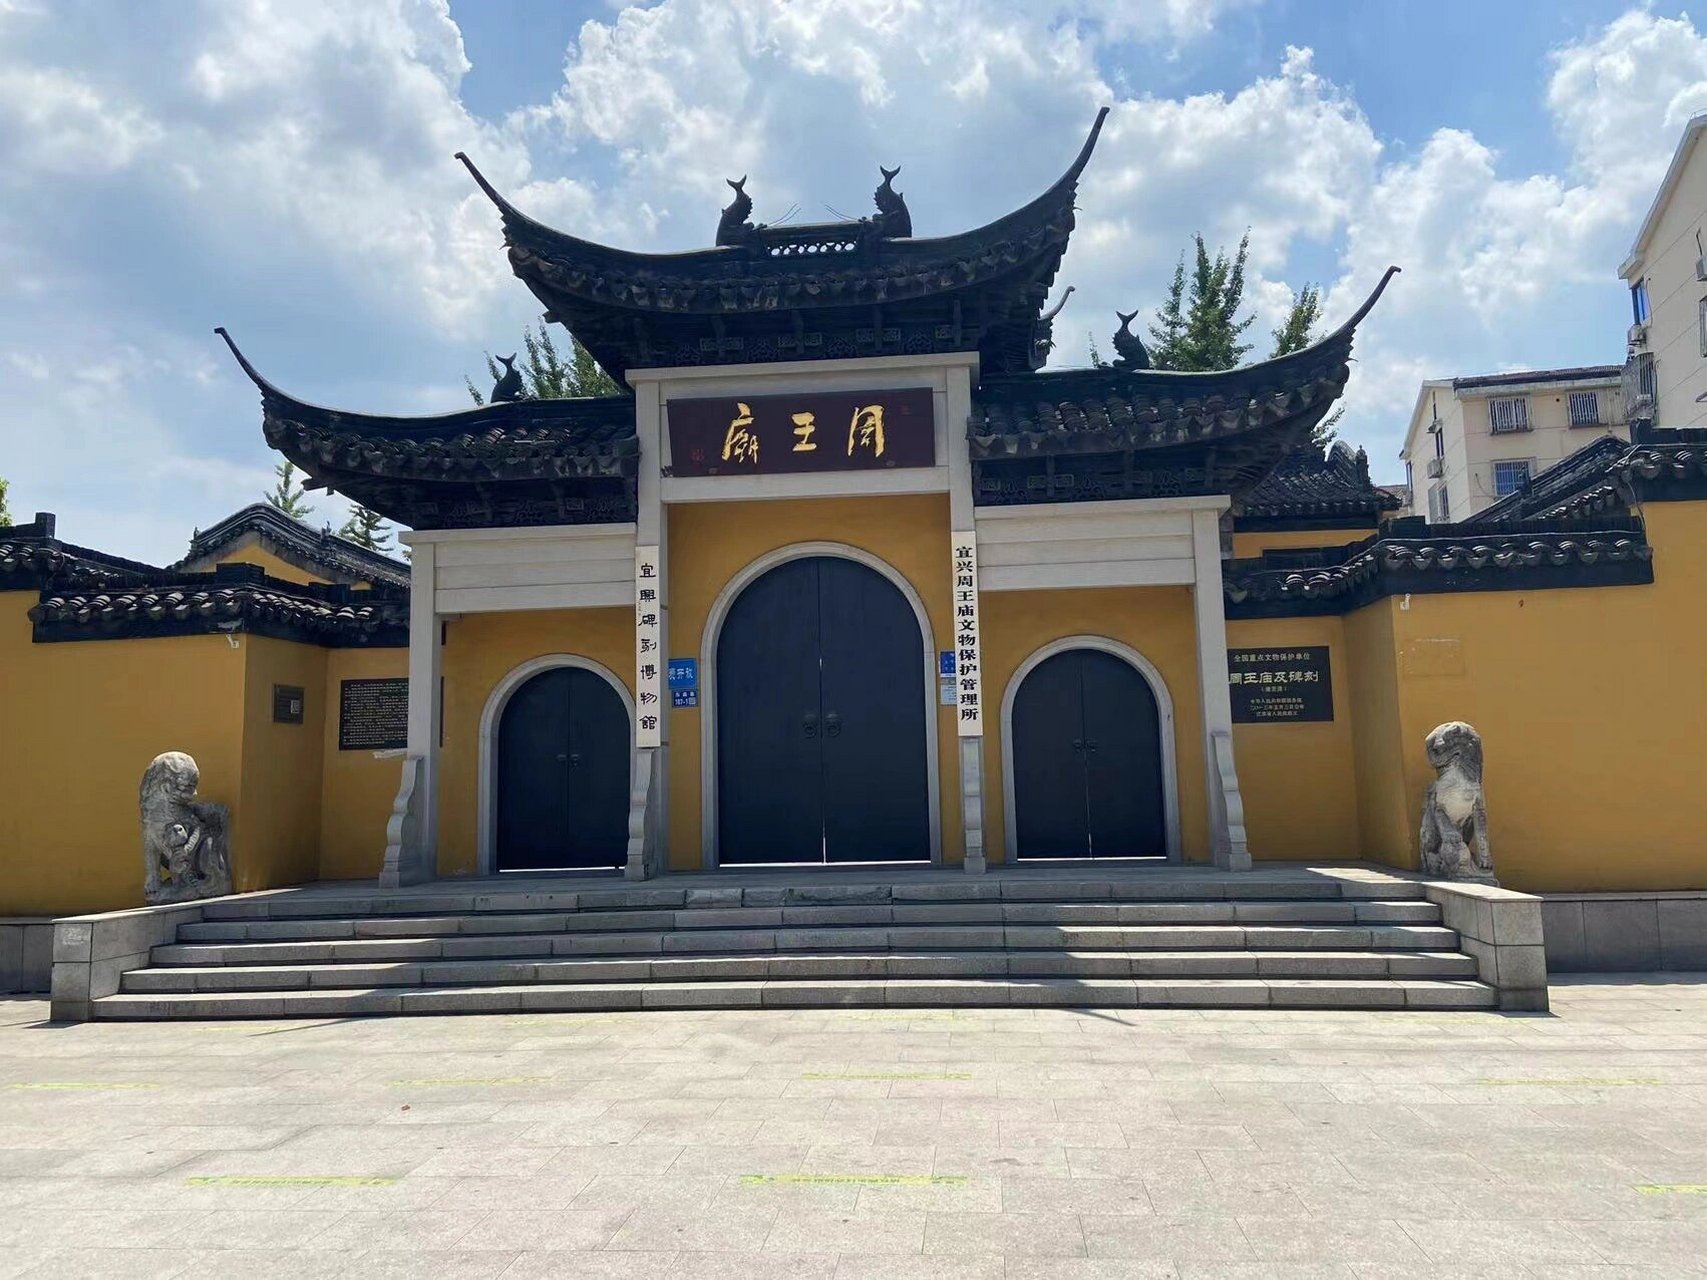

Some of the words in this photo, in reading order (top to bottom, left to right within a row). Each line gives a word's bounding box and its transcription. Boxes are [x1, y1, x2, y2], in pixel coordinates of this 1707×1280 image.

[955, 546, 980, 721] 宜兴周王庙文物保护管理所
[1233, 652, 1311, 662] 全国重点文物保护单位
